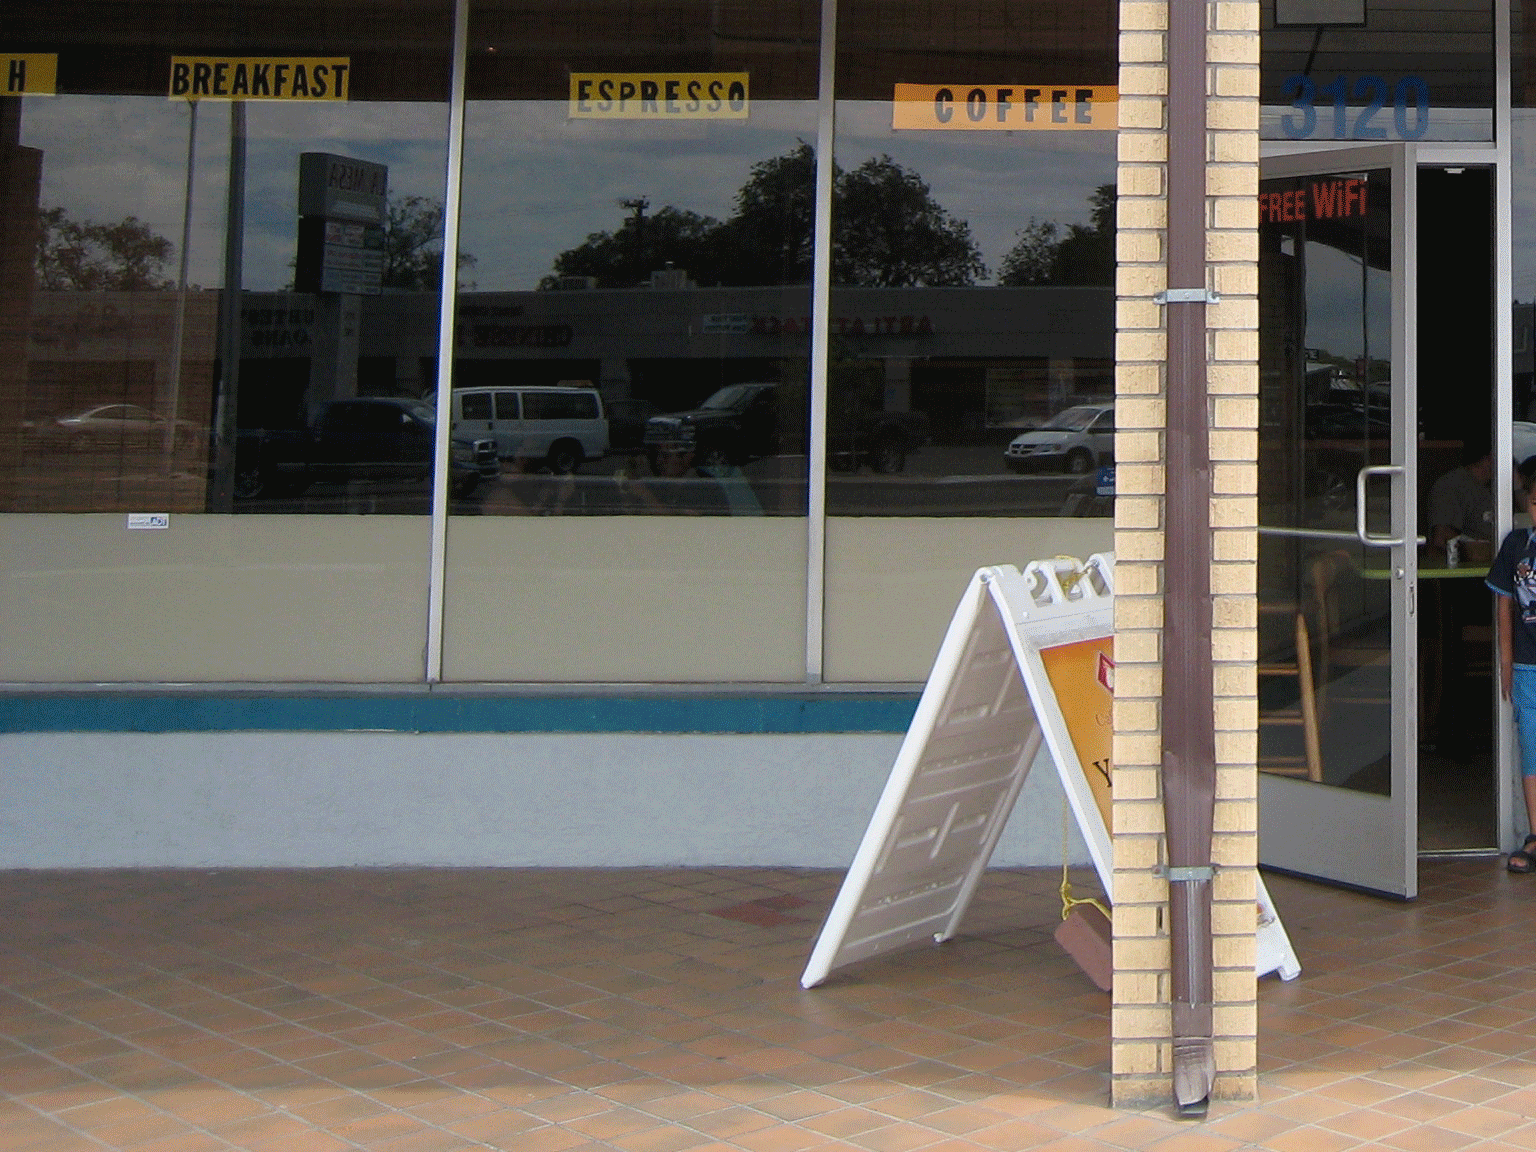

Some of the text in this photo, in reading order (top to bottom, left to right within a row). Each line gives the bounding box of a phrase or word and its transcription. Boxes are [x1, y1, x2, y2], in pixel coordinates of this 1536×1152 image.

[172, 62, 348, 98] BREAKFAST
[577, 79, 745, 114] ESPRESSO
[934, 88, 1093, 125] COFFEE
[1280, 74, 1429, 140] 3120
[1259, 190, 1306, 223] FREE
